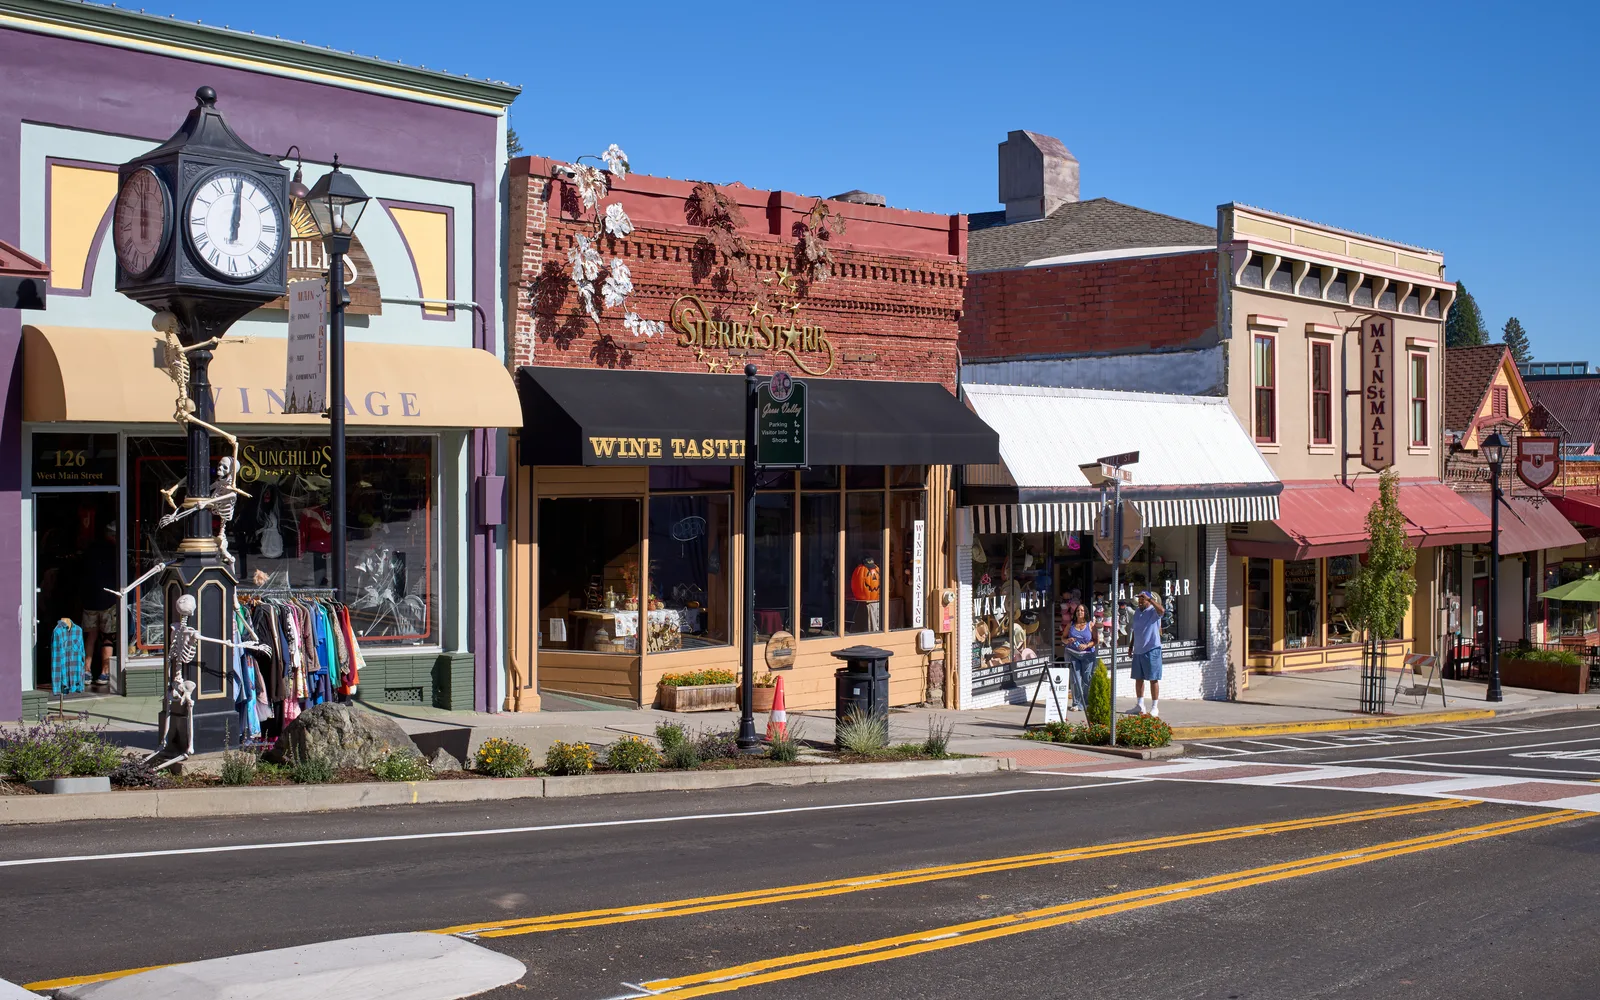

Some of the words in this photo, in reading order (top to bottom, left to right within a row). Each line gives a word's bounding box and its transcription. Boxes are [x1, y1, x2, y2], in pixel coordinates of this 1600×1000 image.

[297, 290, 315, 301] MAIN
[671, 295, 758, 351] SIERRA
[1370, 323, 1385, 384] MAIN
[1370, 401, 1385, 461] MALL
[54, 449, 86, 468] 126
[589, 437, 662, 459] WINE
[36, 471, 56, 480] West
[58, 471, 79, 480] Main
[80, 471, 103, 480] Street
[915, 524, 923, 557] WINE
[1165, 579, 1190, 597] BAR
[973, 595, 1007, 617] WALK
[1020, 590, 1047, 611] WEST
